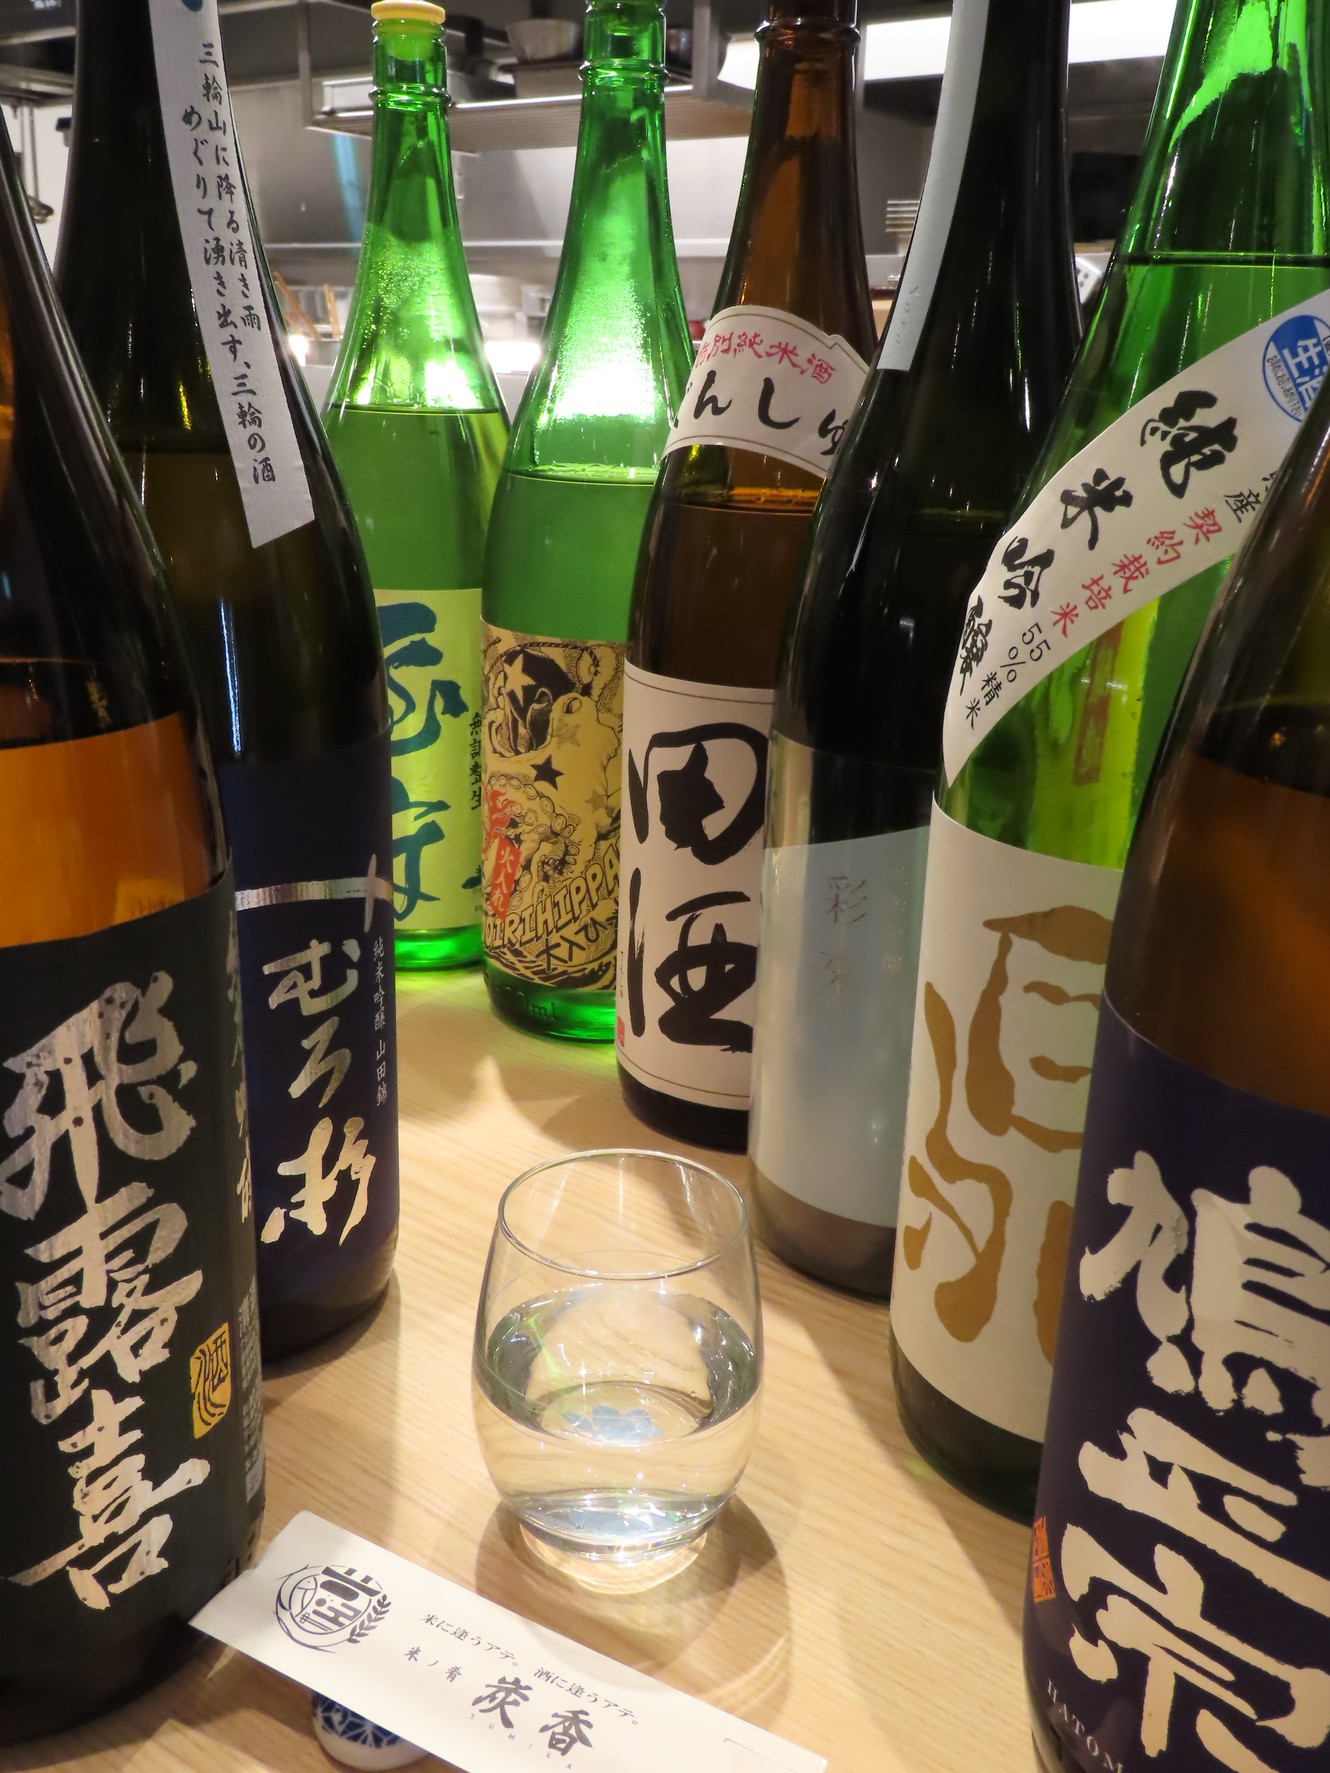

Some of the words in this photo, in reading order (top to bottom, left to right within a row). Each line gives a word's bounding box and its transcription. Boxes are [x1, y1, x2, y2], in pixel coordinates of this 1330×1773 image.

[198, 42, 262, 332] 三輪山に降る清き雨
[471, 1675, 594, 1757] 炭香
